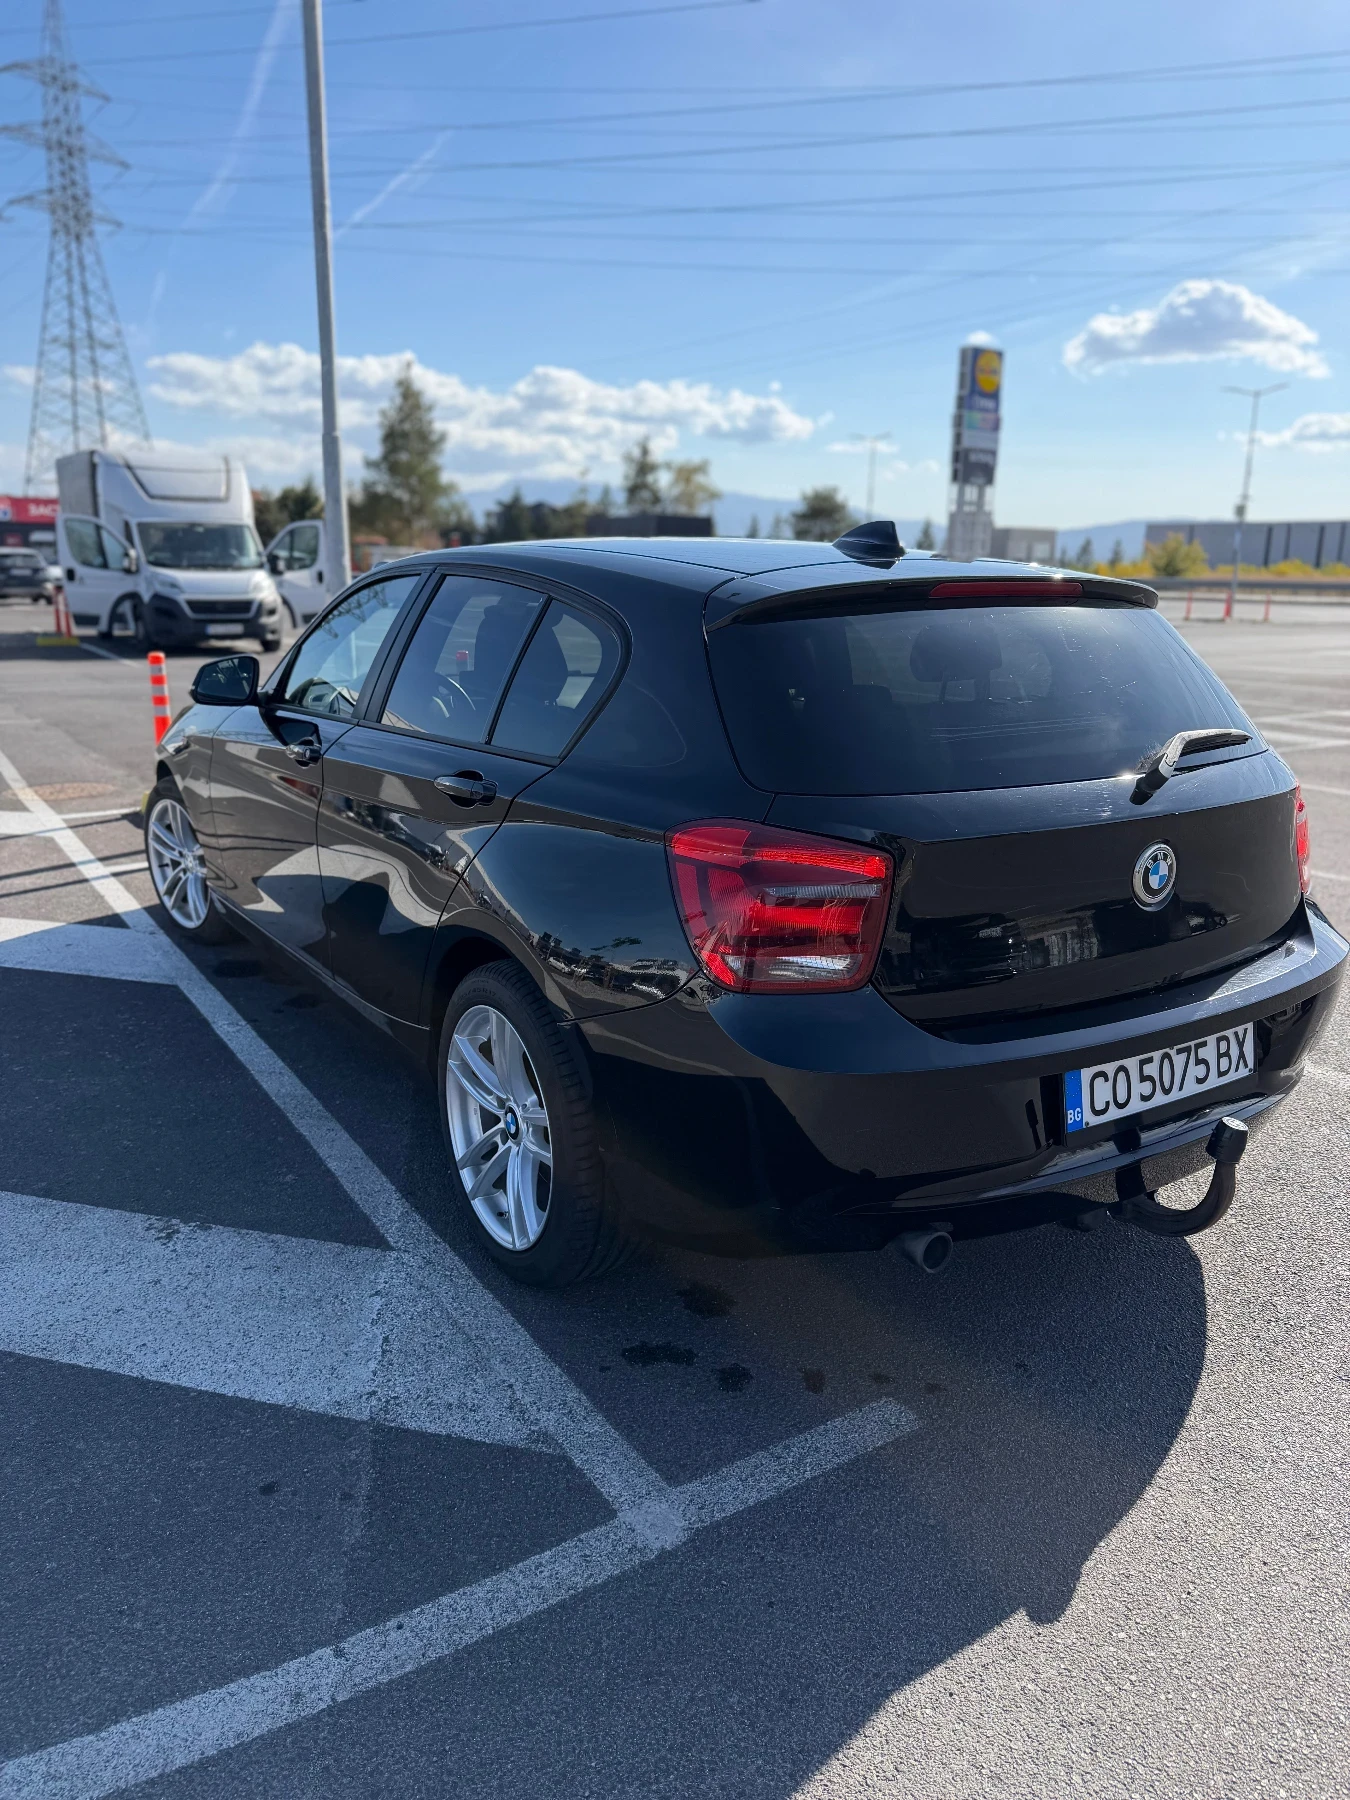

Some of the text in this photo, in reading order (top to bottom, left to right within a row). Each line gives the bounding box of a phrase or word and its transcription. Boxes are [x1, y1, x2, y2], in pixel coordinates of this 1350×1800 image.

[1146, 851, 1173, 869] BMW
[1088, 1027, 1249, 1117] CO 5075 BX
[1067, 1107, 1082, 1125] BG
